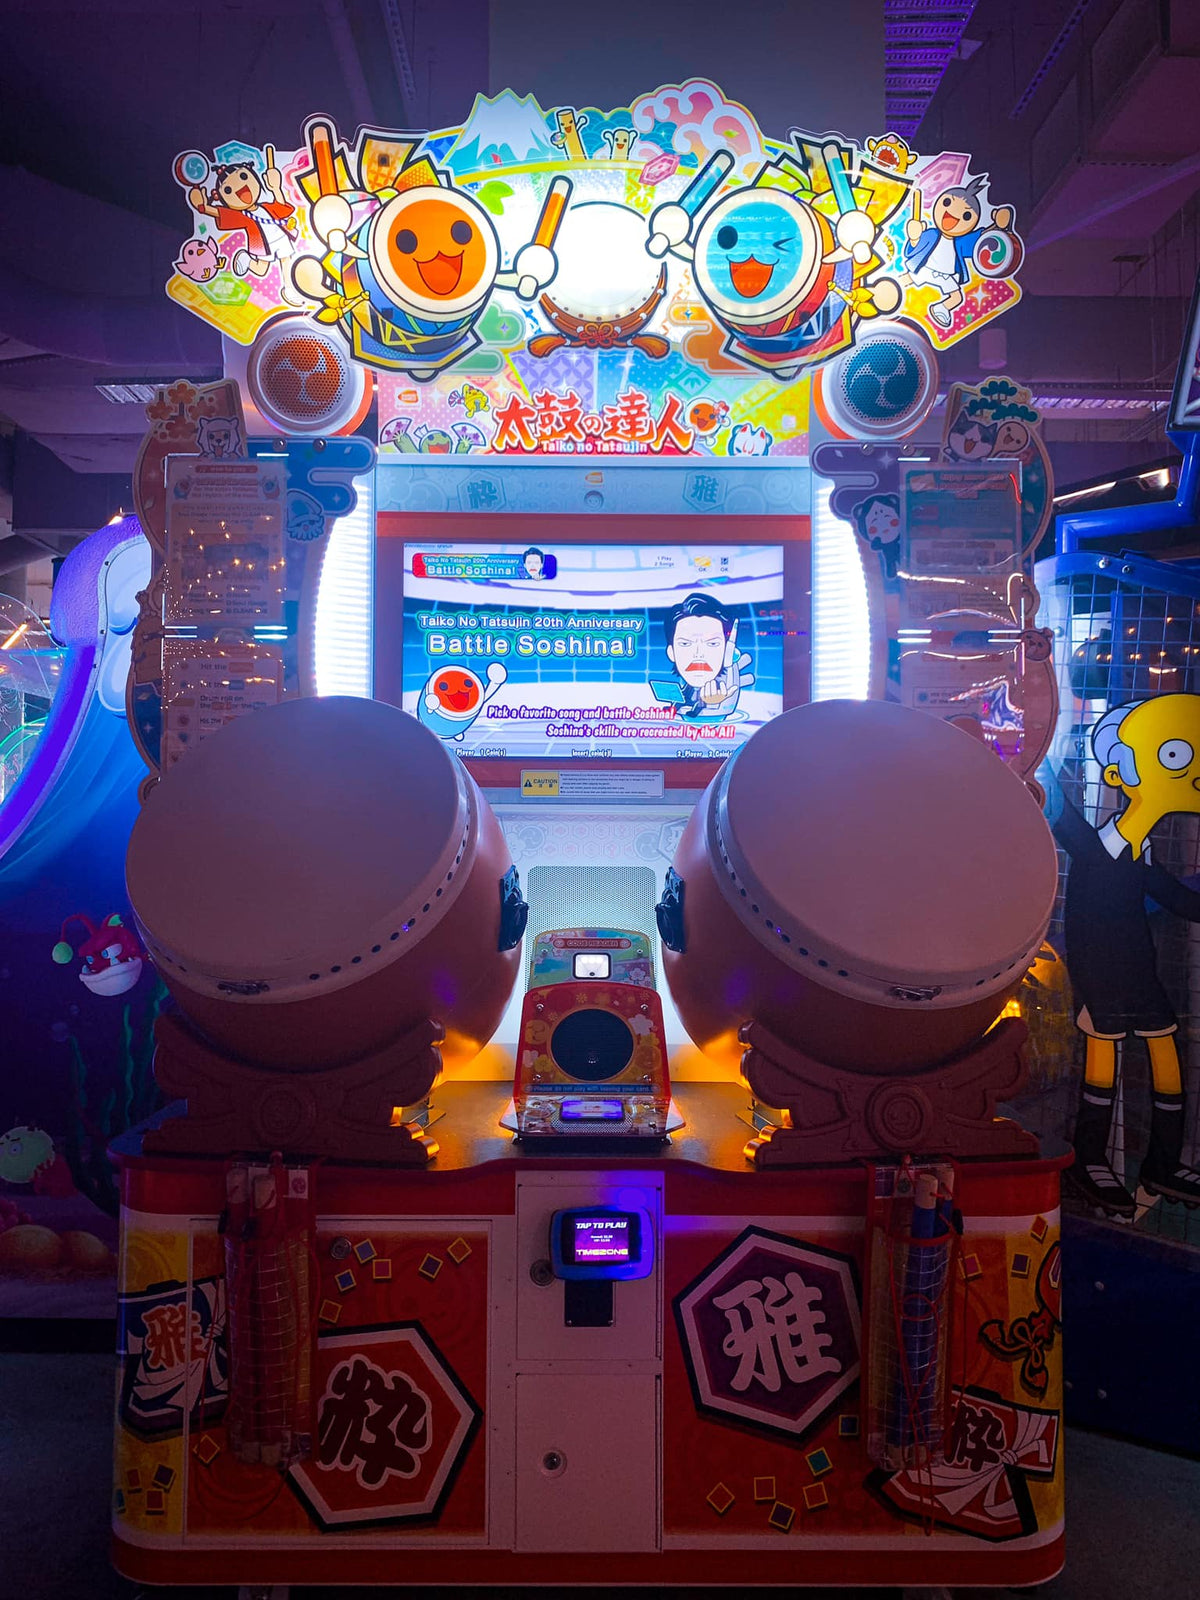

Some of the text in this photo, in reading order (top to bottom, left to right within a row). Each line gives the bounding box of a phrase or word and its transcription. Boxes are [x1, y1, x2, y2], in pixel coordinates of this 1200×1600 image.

[494, 389, 694, 452] 太鼓の達人
[542, 440, 648, 453] Taiko no Tatsujin
[427, 566, 515, 576] Battle Soshina!
[420, 615, 643, 631] Taiko No Tatsujin 20th Anniversary
[429, 635, 634, 655] Battle Soshina!
[488, 705, 676, 721] Pick a favorite song and battle Soshina!
[546, 724, 592, 737] Soshina's
[593, 725, 620, 737] skills
[621, 728, 638, 737] are
[639, 725, 684, 738] recreated
[686, 725, 698, 741] by
[699, 725, 717, 738] the
[713, 1271, 842, 1393] 雅
